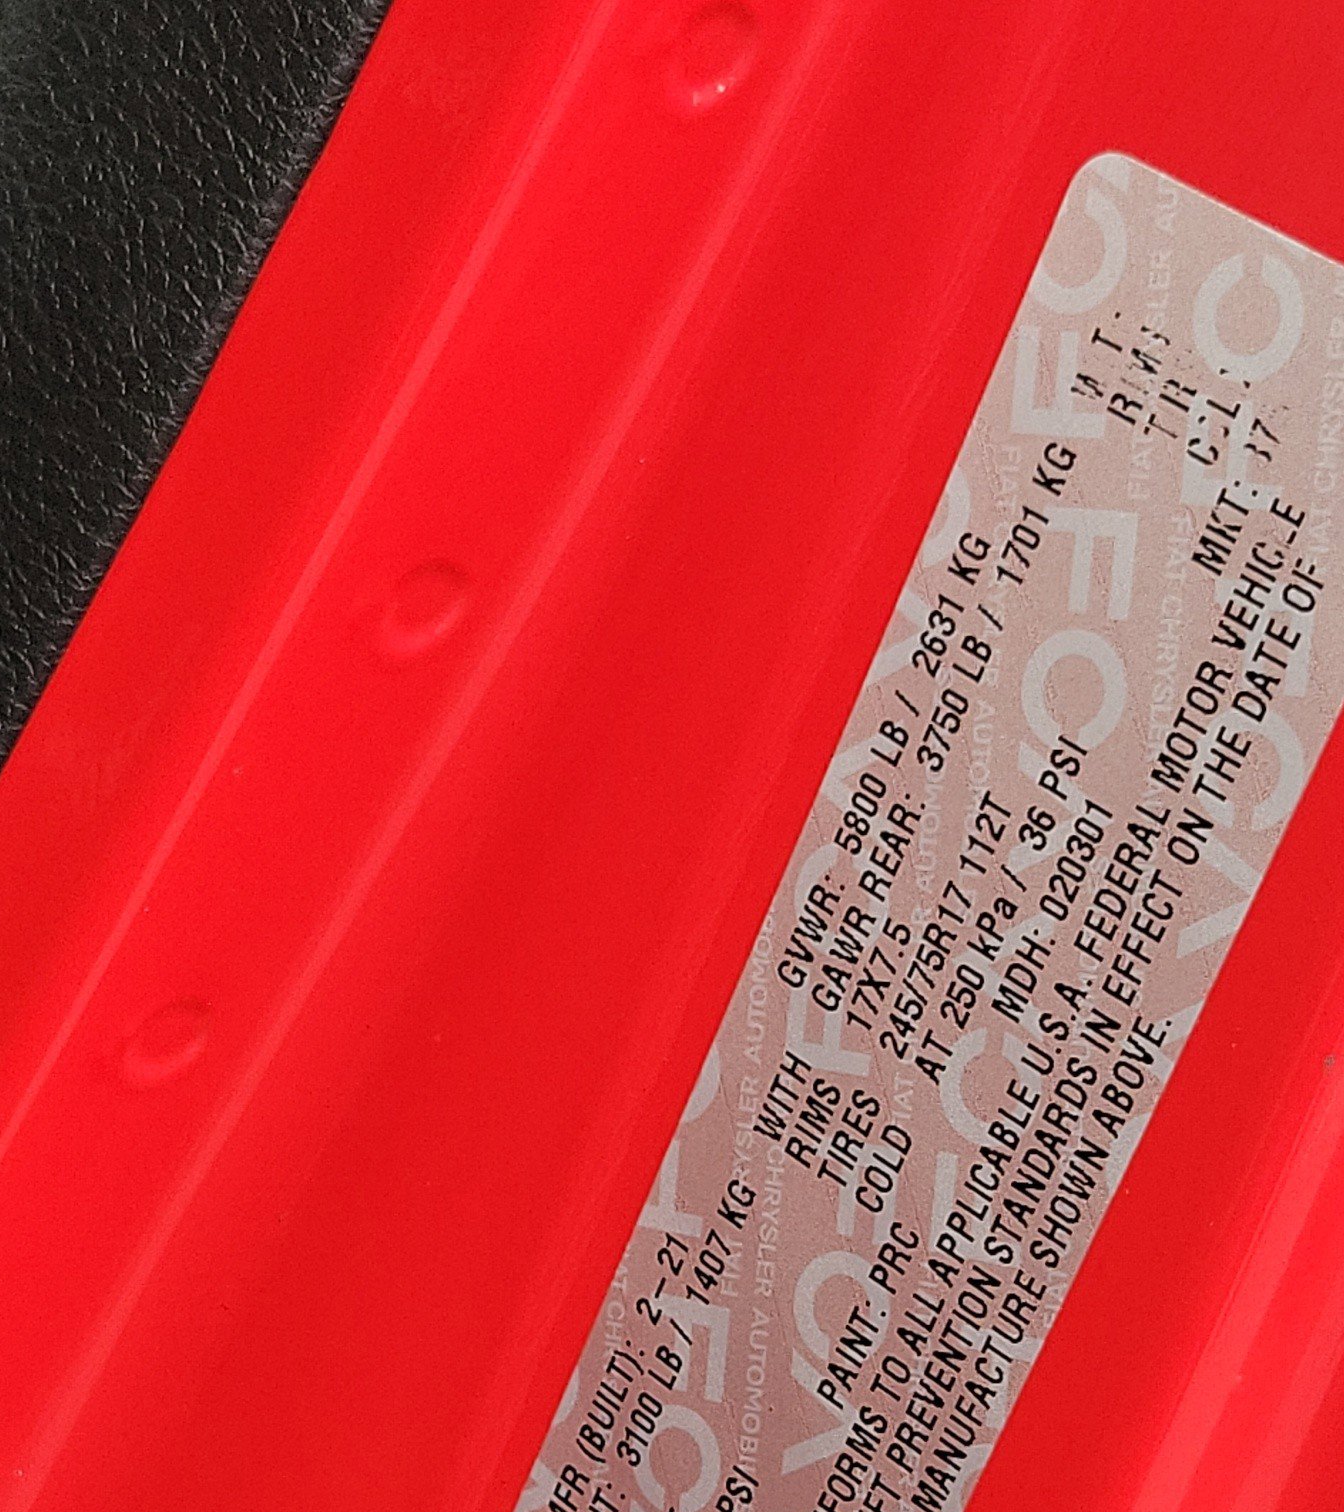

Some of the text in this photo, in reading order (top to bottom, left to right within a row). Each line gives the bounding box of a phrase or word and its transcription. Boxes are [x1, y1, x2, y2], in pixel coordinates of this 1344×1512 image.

[776, 531, 992, 989] GVWR: 5800 LB / 2631 KG
[1018, 805, 1057, 852] 36
[1037, 734, 1088, 801] PSI
[615, 1391, 663, 1467] 3100
[647, 1344, 683, 1392] LB
[668, 1317, 694, 1347] /
[685, 1227, 732, 1306] 1407
[716, 1178, 757, 1230] KG
[752, 1050, 813, 1142] WITH
[810, 905, 877, 1012] GAWR
[857, 792, 927, 903] REAR:
[915, 688, 970, 773] 3750
[951, 634, 993, 684] LB
[976, 603, 1004, 632] /
[996, 504, 1050, 586] 1701
[1031, 441, 1078, 497] KG
[816, 1299, 887, 1411] PAINT:
[868, 1221, 920, 1296] PRC
[990, 929, 1057, 1025] MDH:
[1038, 798, 1114, 922] 020301
[1190, 480, 1258, 577] MKT:
[966, 896, 1019, 962] kPa
[999, 863, 1028, 893] /
[784, 1077, 842, 1170] RIMS
[846, 916, 912, 1031] 17X7.5
[816, 1088, 881, 1188] TIRES
[878, 879, 972, 1060] 245/75R17
[959, 789, 1012, 875] 112T
[869, 1355, 912, 1403] TO
[896, 1292, 946, 1358] ALL
[927, 1078, 1041, 1289] APPLICABLE
[1020, 979, 1094, 1076] U.S.A.
[1072, 804, 1172, 963] FEDERAL
[1150, 660, 1235, 794] MOTOR
[885, 1264, 1002, 1475] PREVENTION
[983, 1056, 1098, 1265] STANDARDS
[1079, 1007, 1123, 1055] IN
[1101, 867, 1184, 1007] EFFECT
[1166, 806, 1215, 866] ON
[1191, 725, 1253, 802] THE
[1230, 617, 1302, 723] DATE
[1282, 557, 1325, 613] OF
[914, 1028, 954, 1087] AT
[939, 963, 985, 1031] 250
[855, 1124, 913, 1214] COLD
[1028, 1135, 1110, 1269] SHOWN
[1091, 1014, 1172, 1140] ABOVE.
[575, 1339, 646, 1464] (BUILT):
